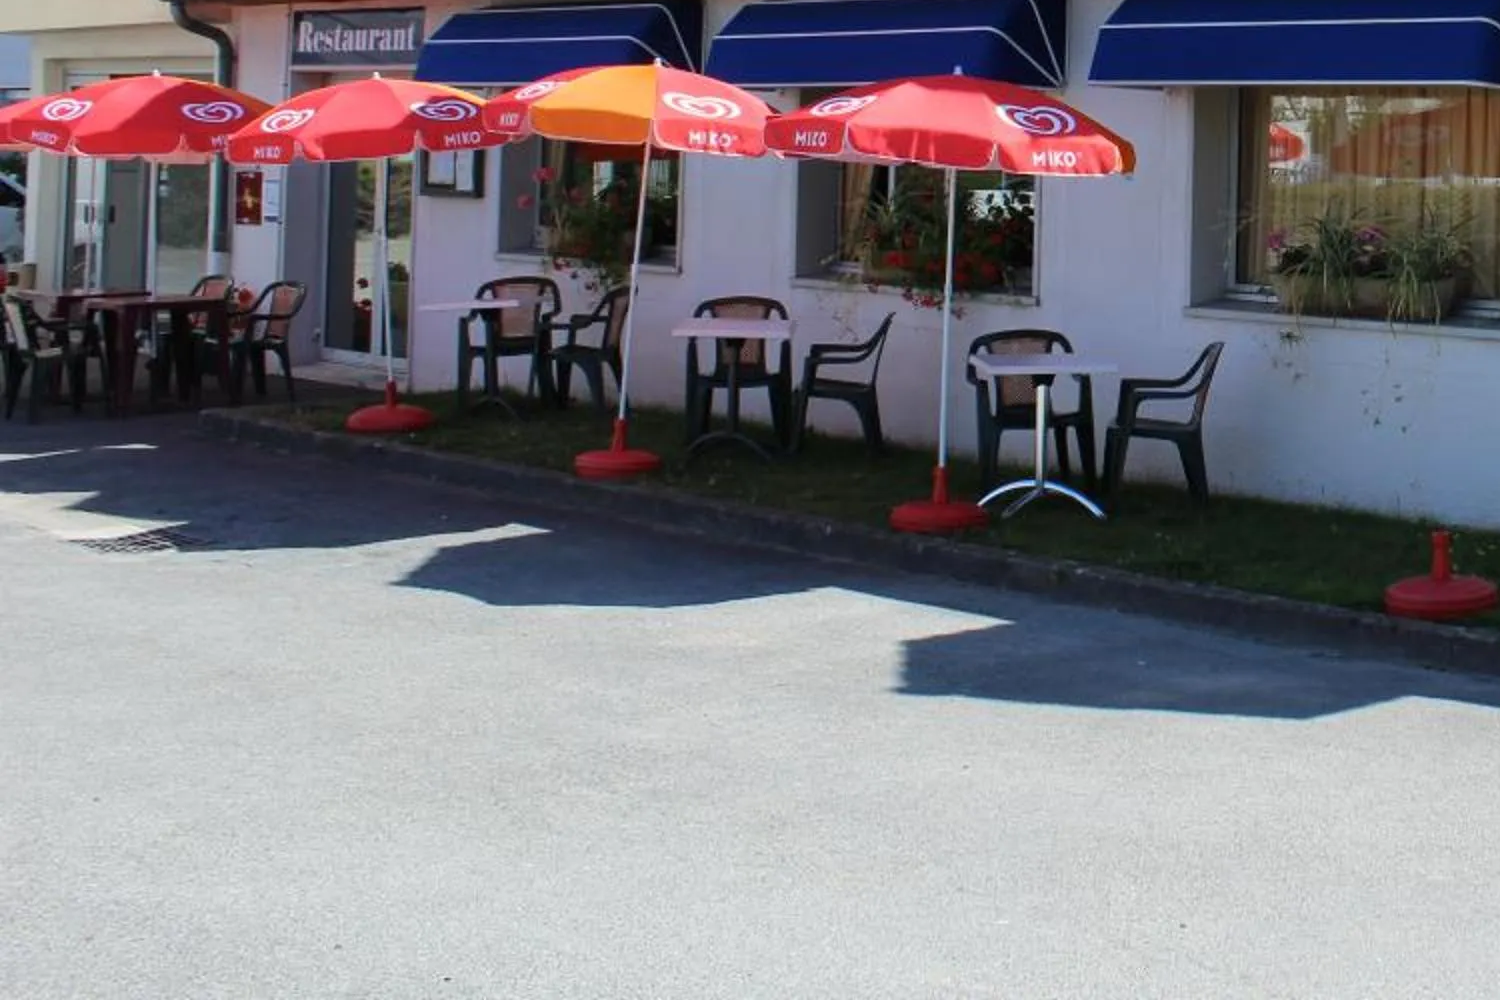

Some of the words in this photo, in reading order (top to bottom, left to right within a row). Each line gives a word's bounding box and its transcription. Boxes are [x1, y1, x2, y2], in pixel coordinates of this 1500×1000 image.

[298, 20, 415, 52] Restaurant
[444, 131, 480, 146] MIKO
[688, 130, 732, 148] MIKO
[795, 131, 827, 147] MIKO
[1032, 151, 1077, 168] MIKO
